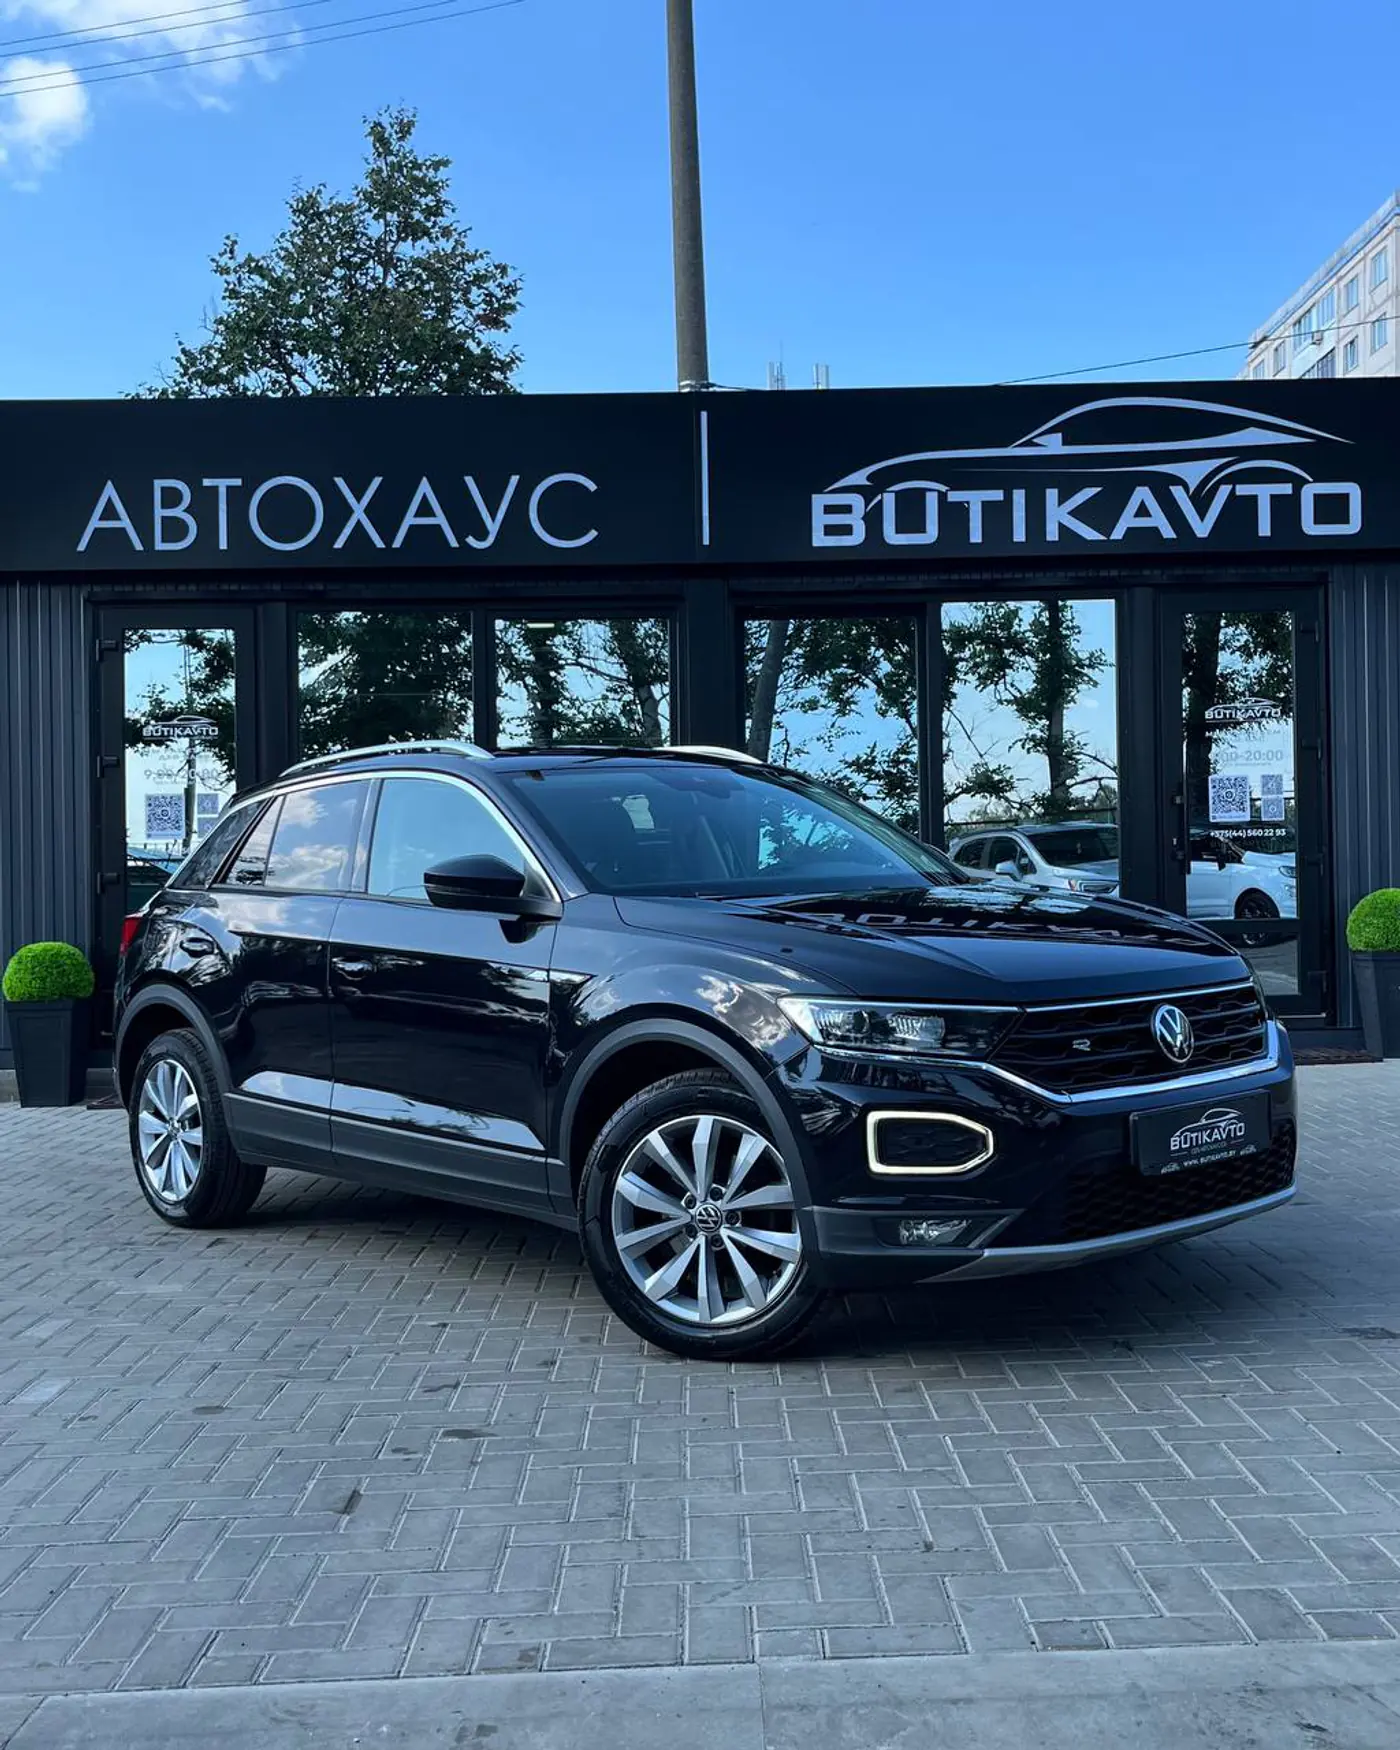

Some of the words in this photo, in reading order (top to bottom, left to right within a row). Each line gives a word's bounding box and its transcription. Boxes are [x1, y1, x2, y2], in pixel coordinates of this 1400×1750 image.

[76, 472, 598, 551] АВТОХАУС
[811, 482, 1362, 546] BUTIKAVTO
[1205, 708, 1281, 719] BUTIKAVTO
[142, 726, 219, 737] BUTIKAVTO
[1263, 828, 1274, 837] 22
[1170, 1122, 1246, 1151] BUTIKAVTO
